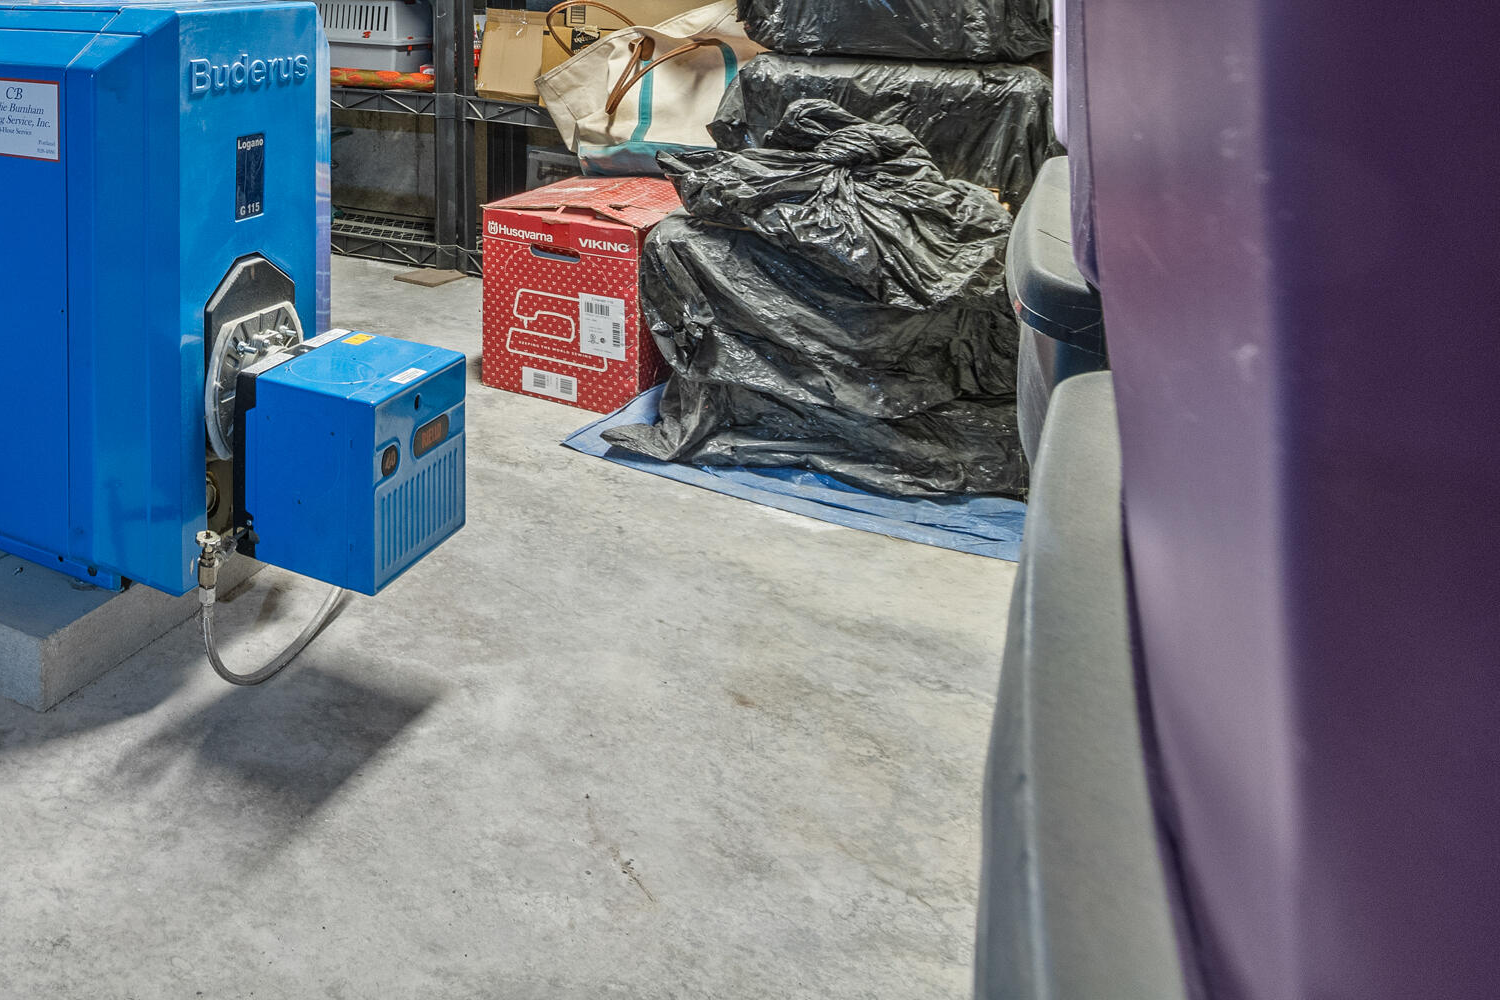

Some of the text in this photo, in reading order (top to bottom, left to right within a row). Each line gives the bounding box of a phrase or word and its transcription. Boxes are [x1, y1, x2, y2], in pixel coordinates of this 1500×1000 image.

[190, 54, 310, 96] Buderus
[5, 86, 23, 100] CB
[9, 103, 44, 115] Burnham
[6, 115, 34, 127] Service,
[36, 118, 51, 128] Inc.
[15, 128, 32, 136] Service
[237, 138, 264, 151] Logano
[239, 201, 260, 216] G 115
[499, 223, 554, 243] Husqvarna
[578, 237, 630, 254] VIKING
[518, 340, 540, 349] KEEPING
[552, 346, 570, 355] WORLD
[571, 350, 592, 359] SEWING
